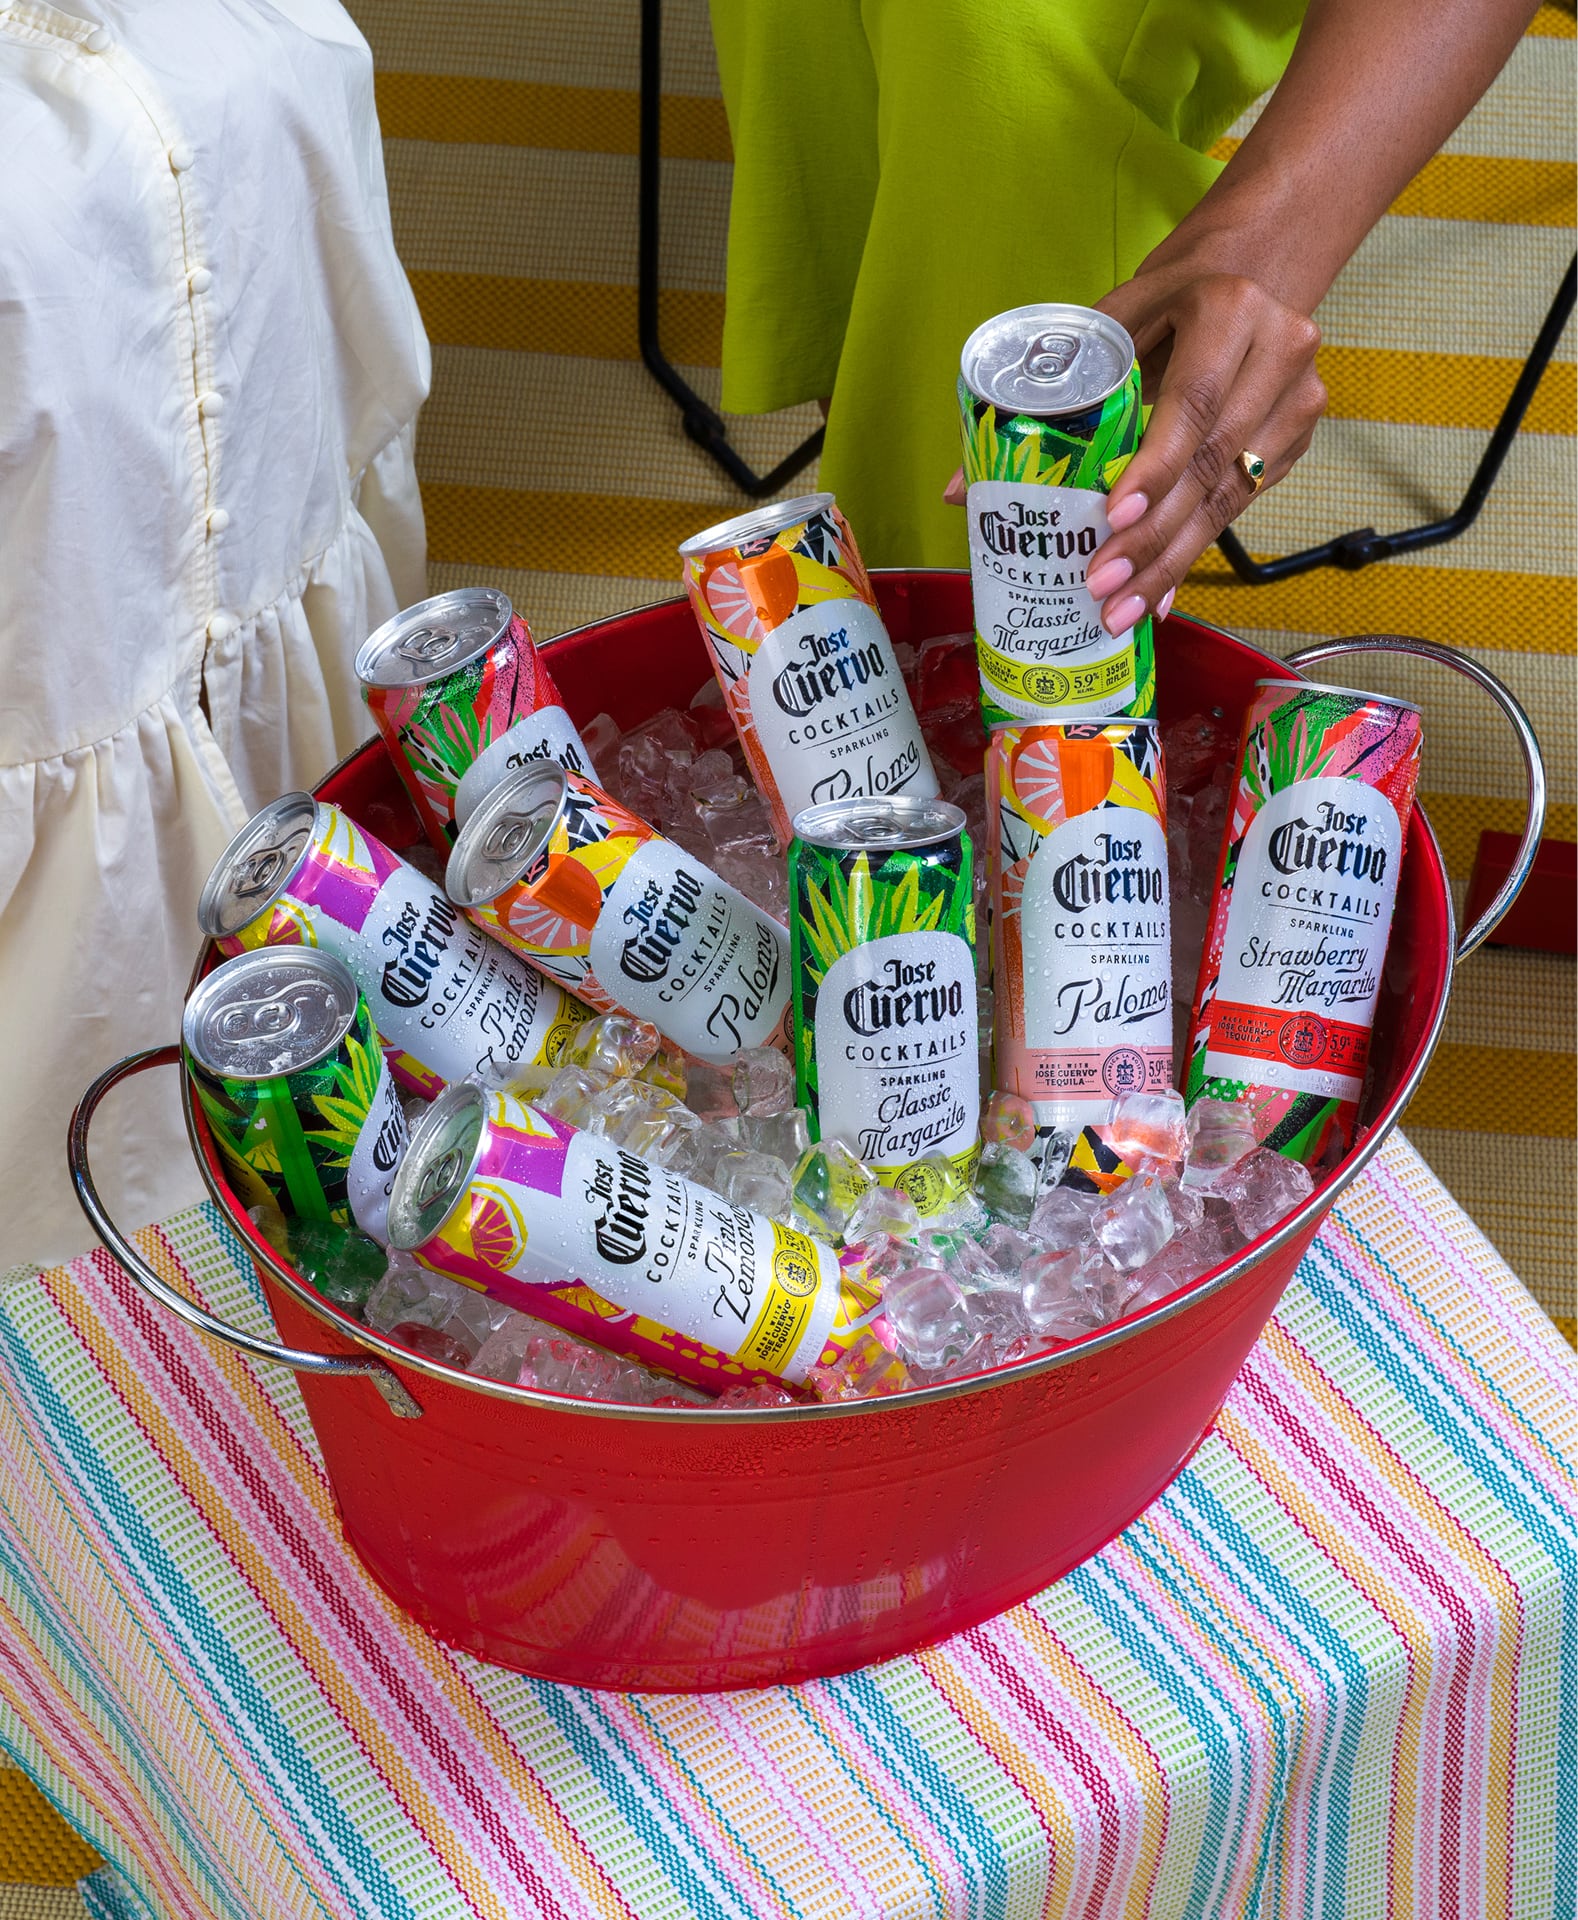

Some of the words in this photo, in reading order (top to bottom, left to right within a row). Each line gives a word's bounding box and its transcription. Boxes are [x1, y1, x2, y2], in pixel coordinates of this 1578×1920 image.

[1008, 502, 1061, 528] Jose
[980, 511, 1097, 560] Cuervo
[982, 553, 1087, 587] COCKTAIL
[1007, 606, 1081, 629] Classic
[1008, 591, 1075, 606] SPARKLING
[799, 627, 850, 668] Jose
[992, 621, 1103, 660] Margarita
[1074, 672, 1099, 689] 5.9%
[1106, 657, 1128, 677] 355ml
[789, 688, 899, 745] COCKTAILS
[830, 728, 889, 759] SPARKLING
[1312, 801, 1368, 836] Jose
[1093, 833, 1142, 867] Jose
[623, 879, 663, 937] Jose
[1262, 881, 1381, 918] COCKTAILS
[382, 901, 421, 959] Jose
[1054, 922, 1165, 939] COCKTAILS
[1290, 918, 1354, 938] SPARKLING
[658, 892, 727, 1003] COCKTAILS
[704, 933, 741, 993] SPARKLING
[1091, 954, 1150, 964] SPARKLING
[1240, 937, 1369, 974] Strawberry
[420, 931, 482, 1029] COCKTAIL
[465, 958, 499, 1017] SPARKLING
[707, 920, 779, 1055] Paloma
[884, 959, 936, 992] Jose
[1271, 967, 1376, 1007] Margarita
[476, 962, 539, 1077] Lemonad
[480, 969, 522, 1048] Pink
[1053, 975, 1168, 1035] Paloma
[845, 1030, 966, 1061] COCKTAILS
[880, 1069, 946, 1087] SPARKLING
[1035, 1070, 1055, 1079] JOSE
[1045, 1078, 1085, 1087] TEQUILA
[878, 1084, 951, 1123] Classic
[858, 1101, 966, 1161] Margarita
[583, 1159, 615, 1213] Jose
[688, 1200, 704, 1260] SPARKLING
[704, 1210, 737, 1285] Pink
[711, 1194, 755, 1325] Lemonad
[758, 1339, 775, 1360] JOSE
[772, 1315, 795, 1353] TEQUILA
